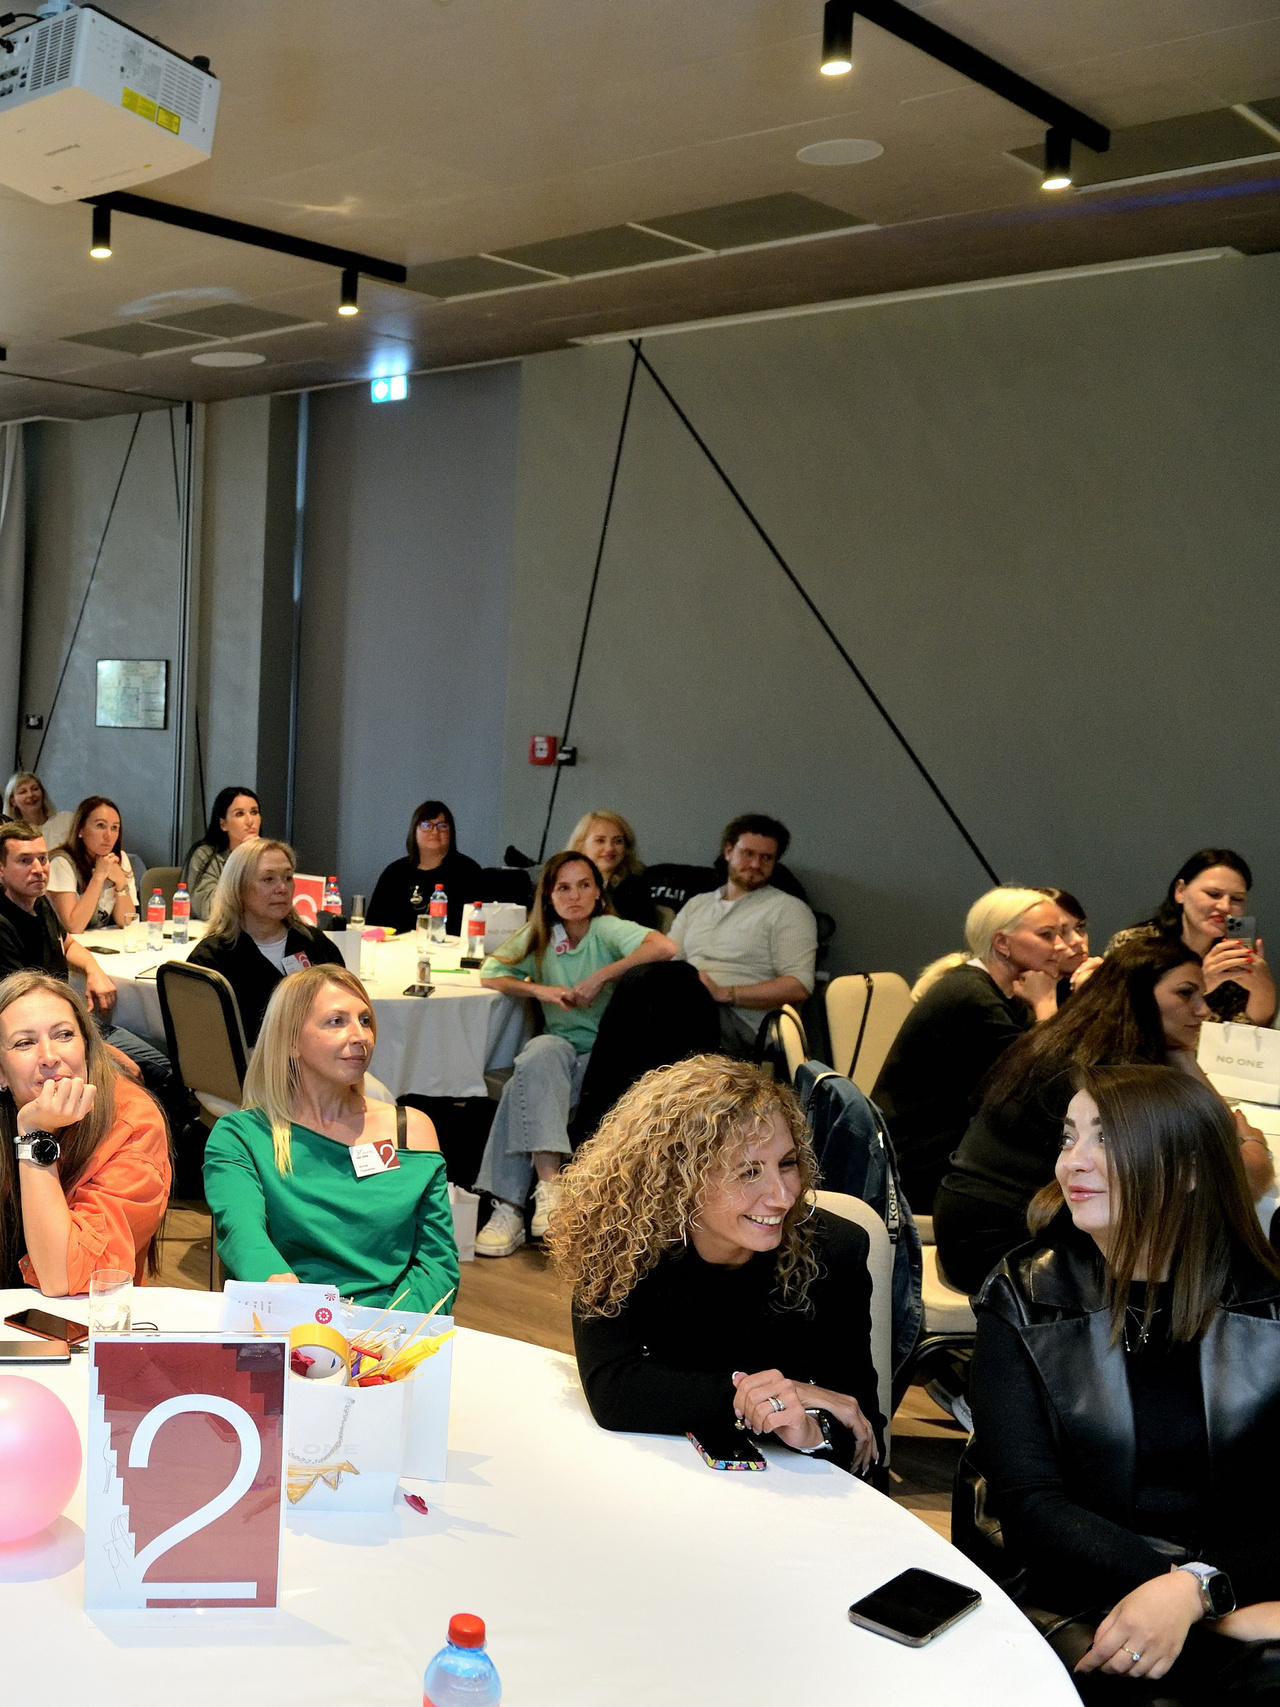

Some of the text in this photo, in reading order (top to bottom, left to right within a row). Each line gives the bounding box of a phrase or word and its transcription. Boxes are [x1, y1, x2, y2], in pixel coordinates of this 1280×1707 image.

[1216, 1055, 1264, 1069] NO ONE
[380, 1143, 401, 1169] 2
[128, 1393, 262, 1600] 2
